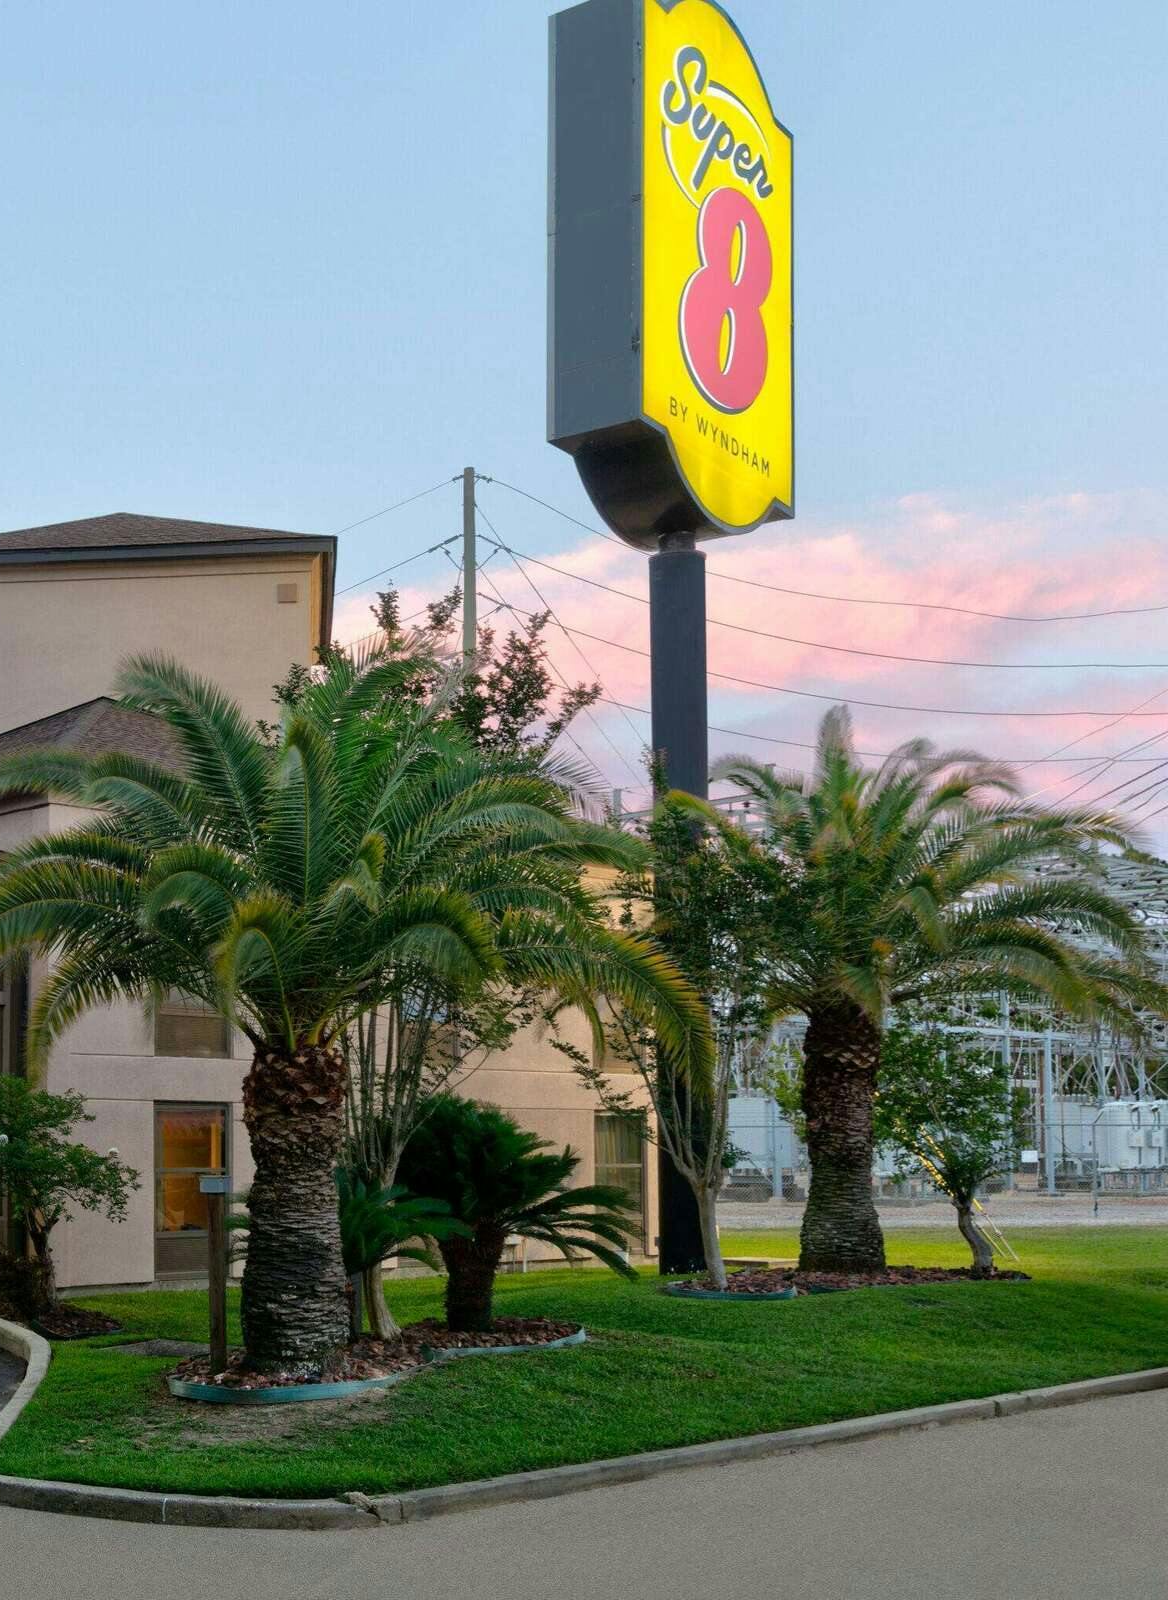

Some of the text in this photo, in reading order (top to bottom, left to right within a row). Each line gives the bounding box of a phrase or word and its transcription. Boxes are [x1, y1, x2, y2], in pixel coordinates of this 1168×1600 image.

[661, 45, 774, 199] Super
[679, 187, 773, 414] 8
[670, 396, 770, 478] BY WYNDHAM
